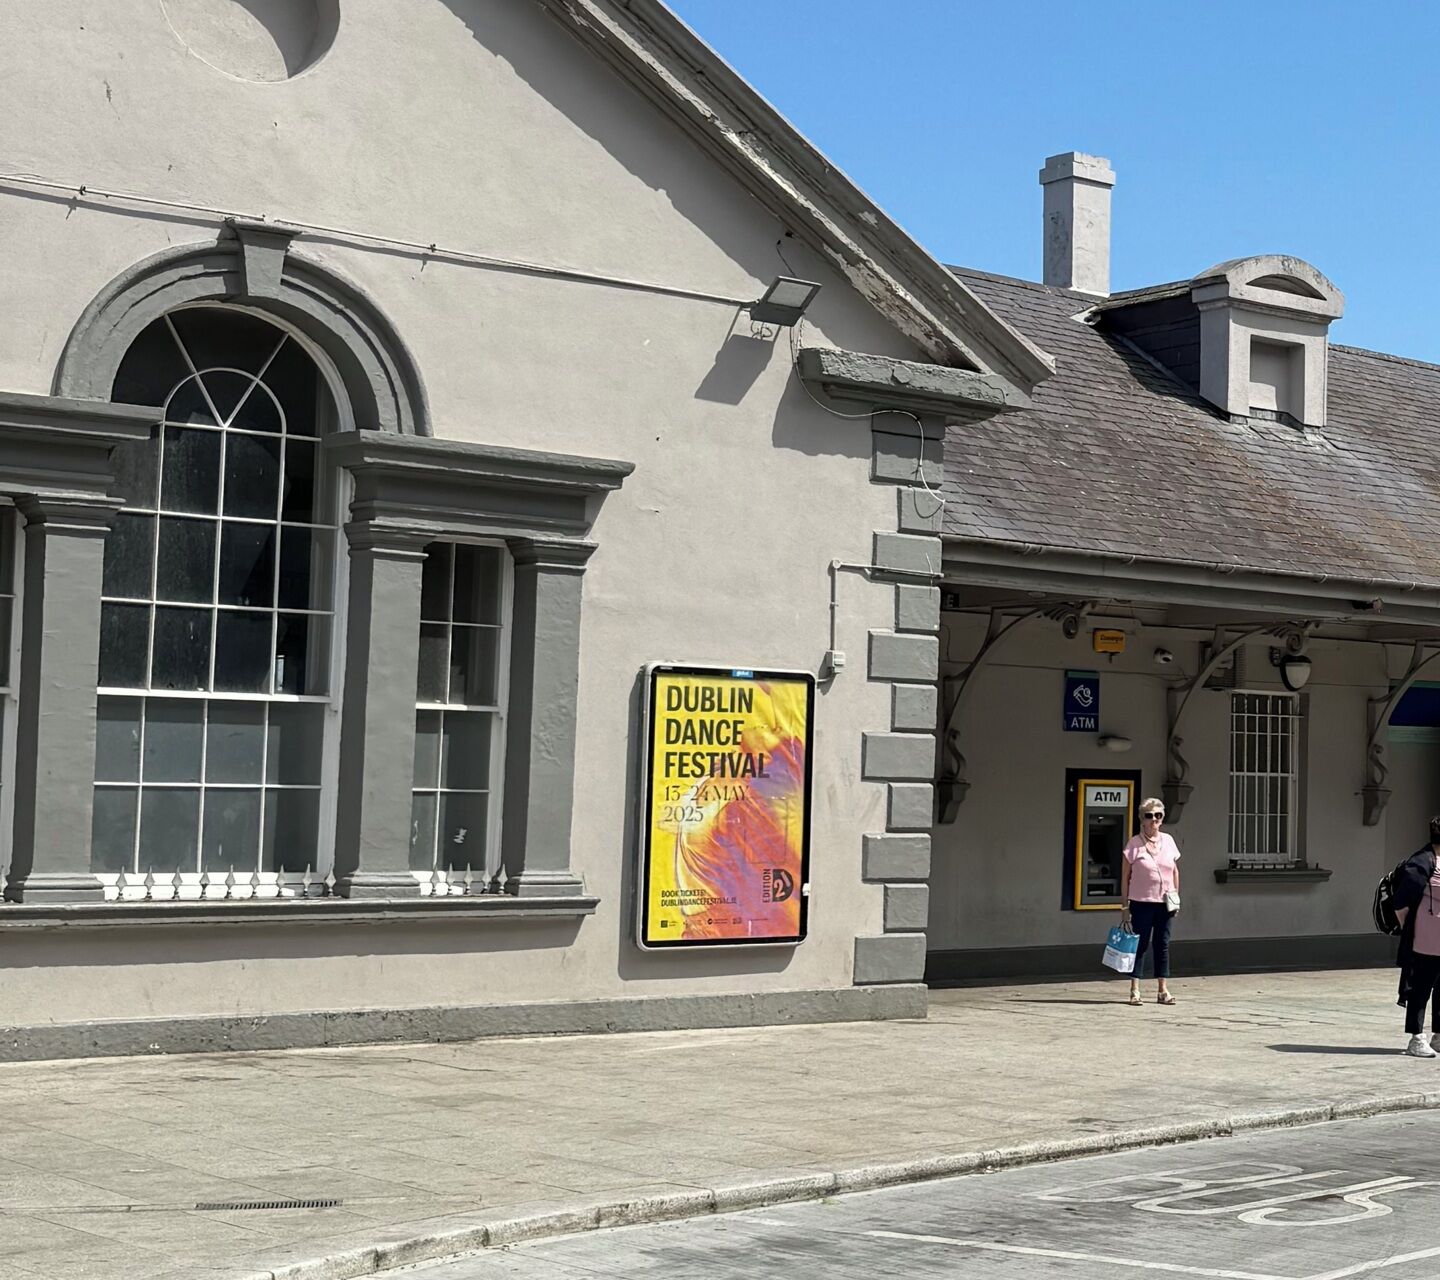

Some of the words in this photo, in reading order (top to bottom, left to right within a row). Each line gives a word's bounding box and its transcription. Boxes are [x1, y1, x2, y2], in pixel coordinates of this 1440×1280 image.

[666, 685, 754, 713] DUBLIN
[1071, 717, 1095, 729] ATM
[665, 719, 745, 746] DANCE
[664, 751, 770, 779] FESTIVAL
[710, 785, 749, 802] MAY
[1094, 792, 1121, 802] ATM
[663, 805, 704, 823] 2025
[661, 890, 679, 898] BOOK
[763, 869, 771, 903] EDITION
